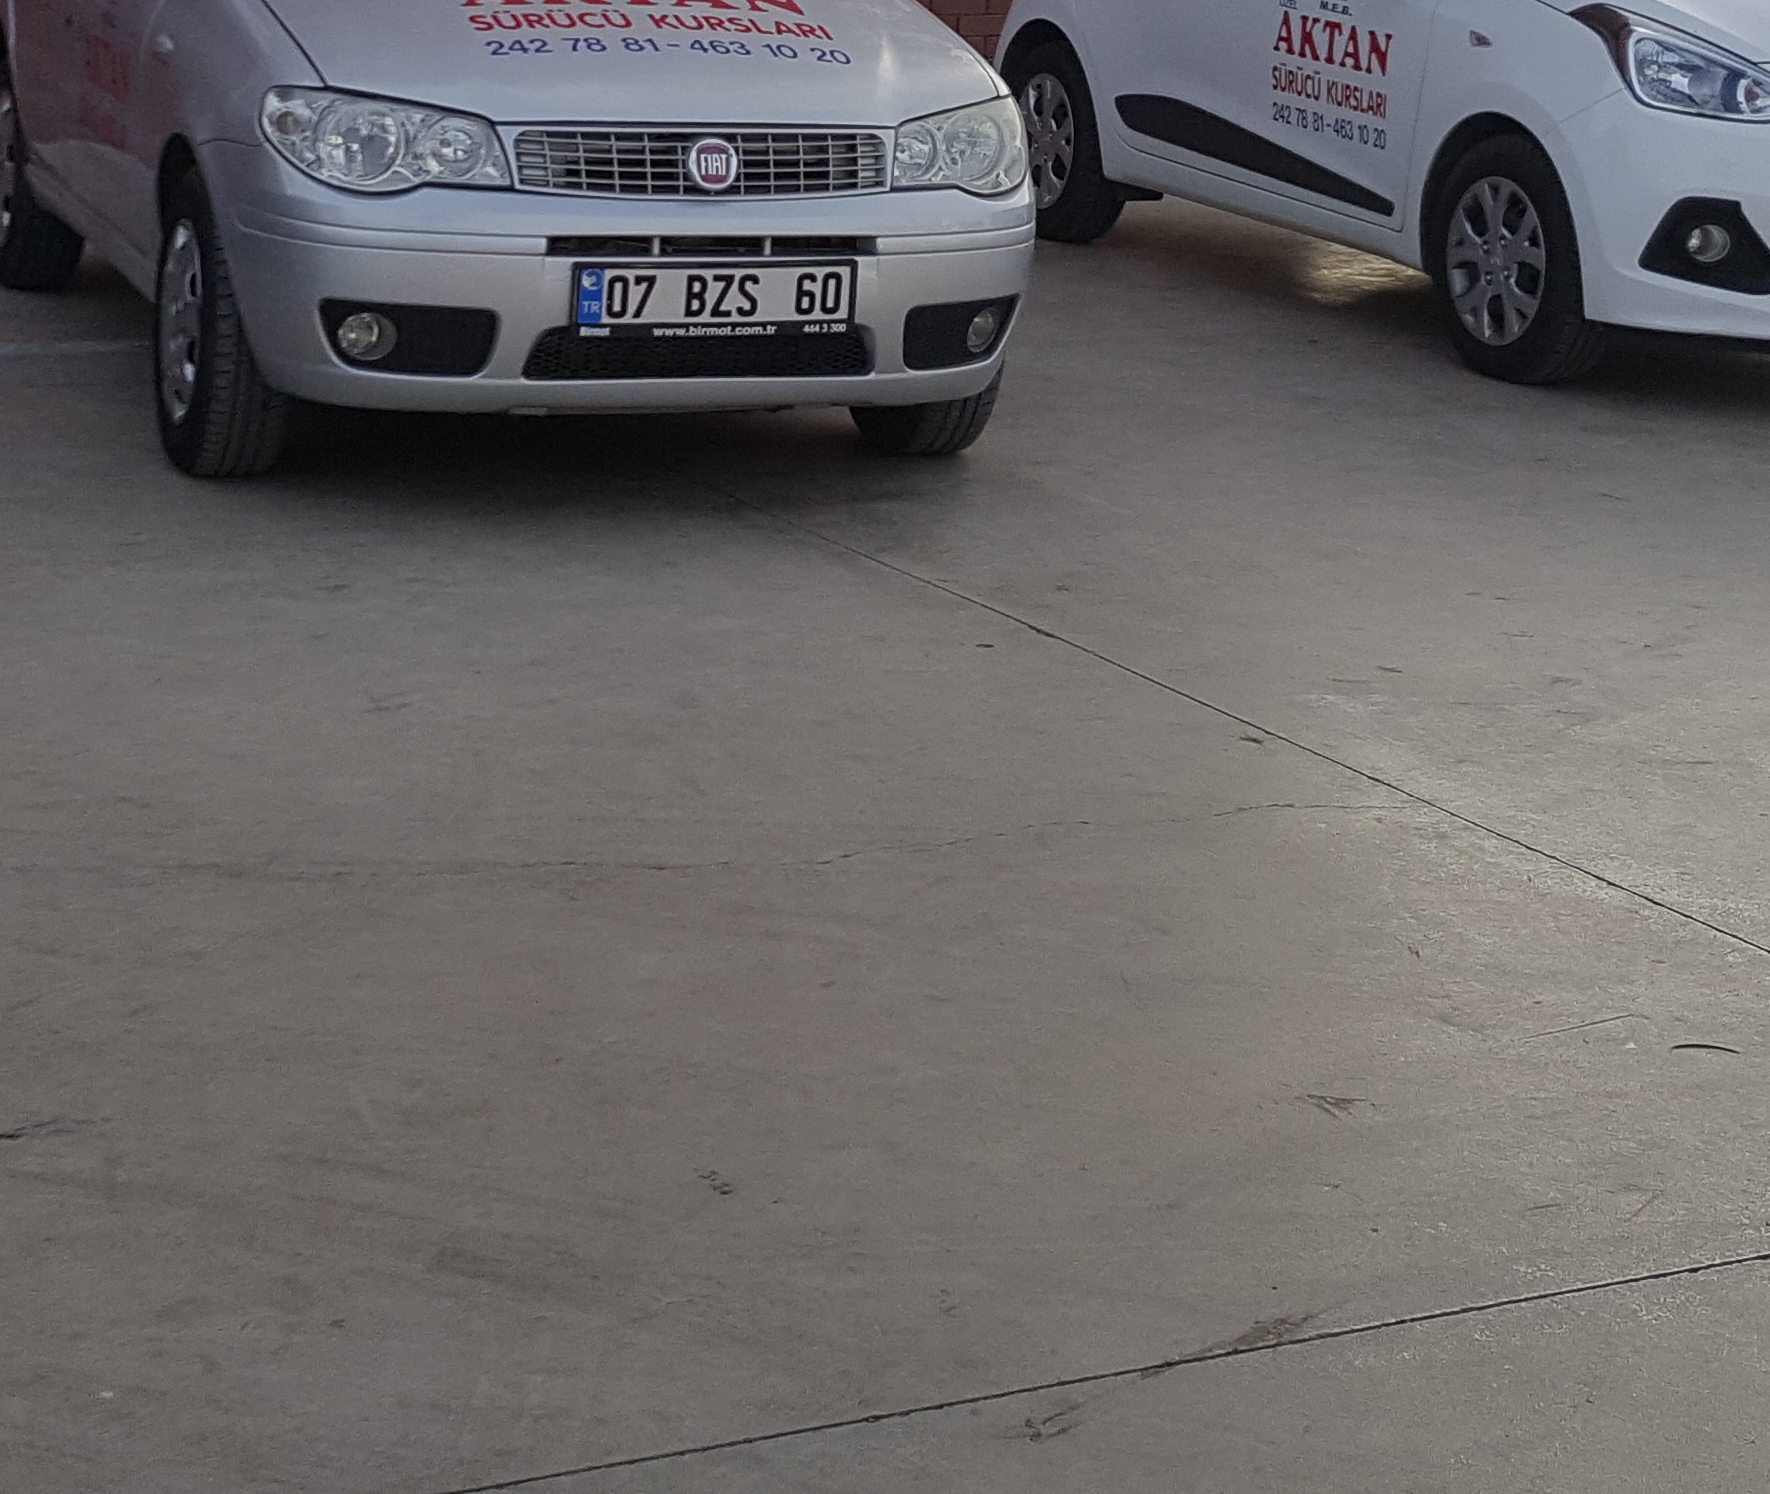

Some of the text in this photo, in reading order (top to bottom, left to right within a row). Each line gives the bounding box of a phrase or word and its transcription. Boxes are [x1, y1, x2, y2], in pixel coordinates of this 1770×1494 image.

[468, 9, 835, 42] SÜRÜCÜ KURSLARI
[485, 38, 554, 56] 242
[560, 37, 608, 53] 78
[762, 43, 799, 61] 10
[809, 47, 853, 66] 20
[1272, 10, 1394, 78] AKTAN
[1272, 62, 1388, 120] SÜRÜCÜ KURSLARI
[1272, 101, 1292, 126] 242
[1295, 107, 1309, 130] 78
[1358, 124, 1370, 145] 10
[1373, 127, 1387, 150] 20
[699, 153, 728, 176] FIAT
[581, 300, 601, 314] TR
[605, 270, 844, 319] 07 BZS 60
[653, 324, 778, 337] www.birmot.com.tr
[821, 323, 828, 333] 3
